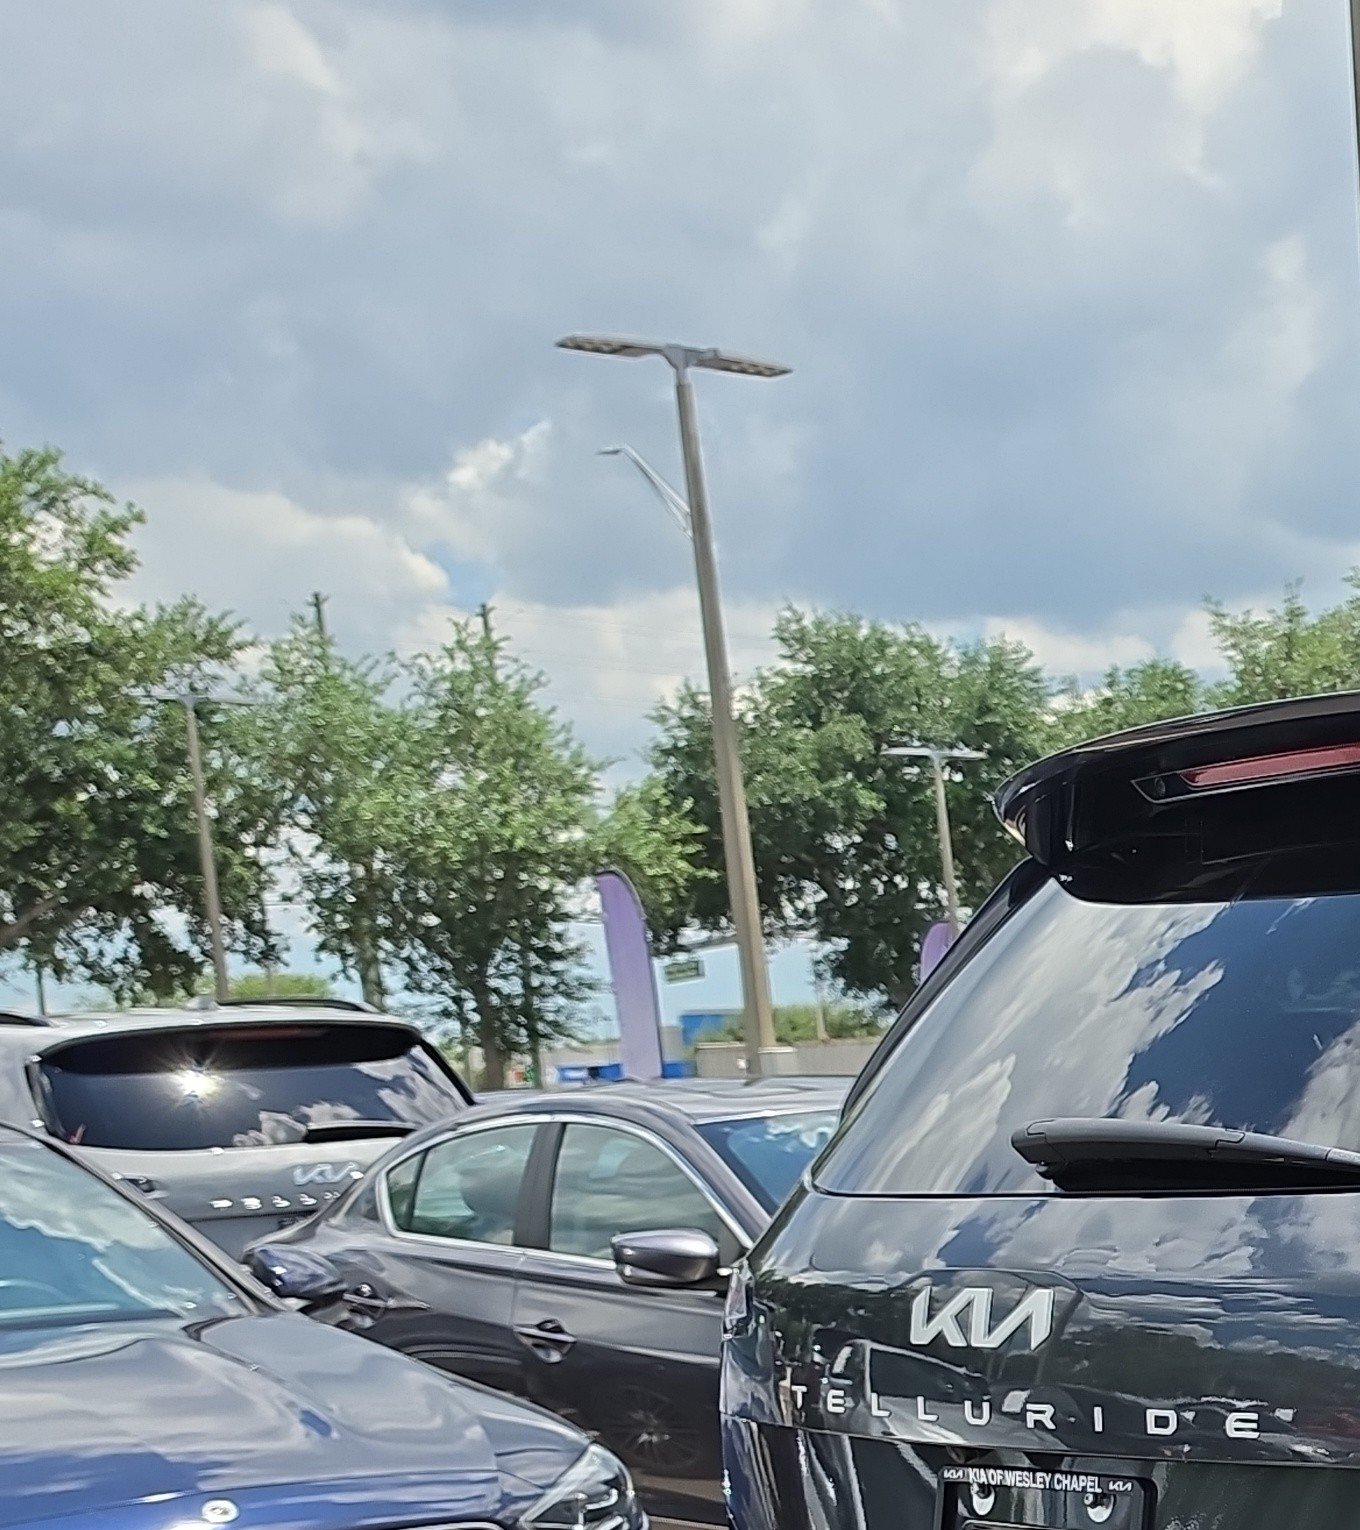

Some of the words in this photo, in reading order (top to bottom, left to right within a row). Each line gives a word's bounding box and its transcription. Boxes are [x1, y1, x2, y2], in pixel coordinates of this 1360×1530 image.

[909, 1286, 1056, 1351] KIA
[791, 1384, 1260, 1439] TELLURIDE
[967, 1467, 987, 1484] KIA
[987, 1469, 1004, 1486] OF
[1004, 1471, 1051, 1489] WESLEY
[1053, 1474, 1103, 1493] CHAPEL
